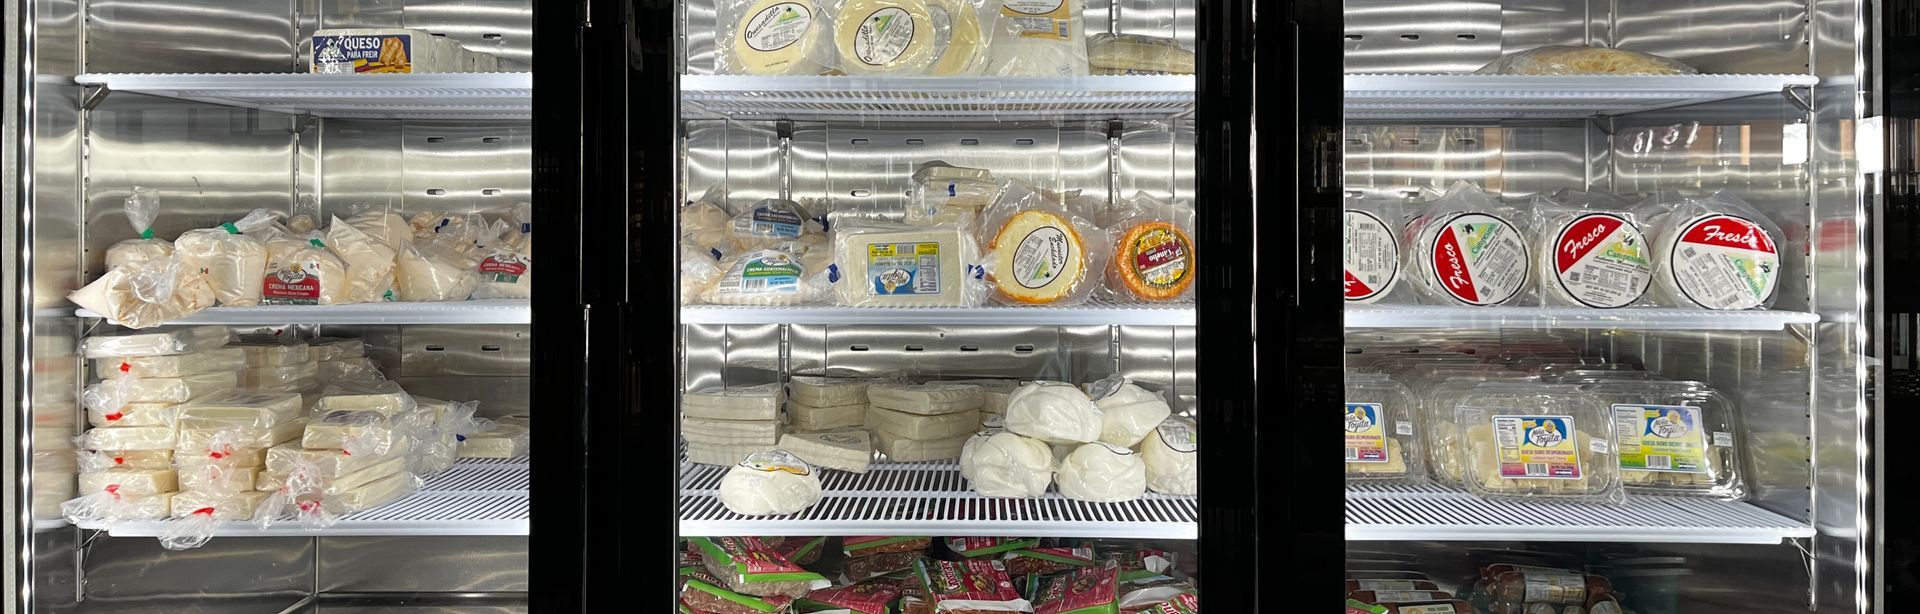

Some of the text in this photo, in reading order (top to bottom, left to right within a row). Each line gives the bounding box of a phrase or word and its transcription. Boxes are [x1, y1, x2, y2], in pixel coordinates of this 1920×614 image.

[746, 6, 780, 39] Quesadilla
[344, 37, 380, 50] QUESO
[1472, 224, 1497, 254] Campesino
[1563, 223, 1607, 260] Fresco
[1444, 242, 1469, 289] Fresco
[1606, 249, 1646, 265] Campesino
[1734, 259, 1761, 296] Campesino
[1347, 420, 1369, 432] Toyita
[1658, 424, 1686, 438] Toyita
[1536, 434, 1560, 447] Toyita
